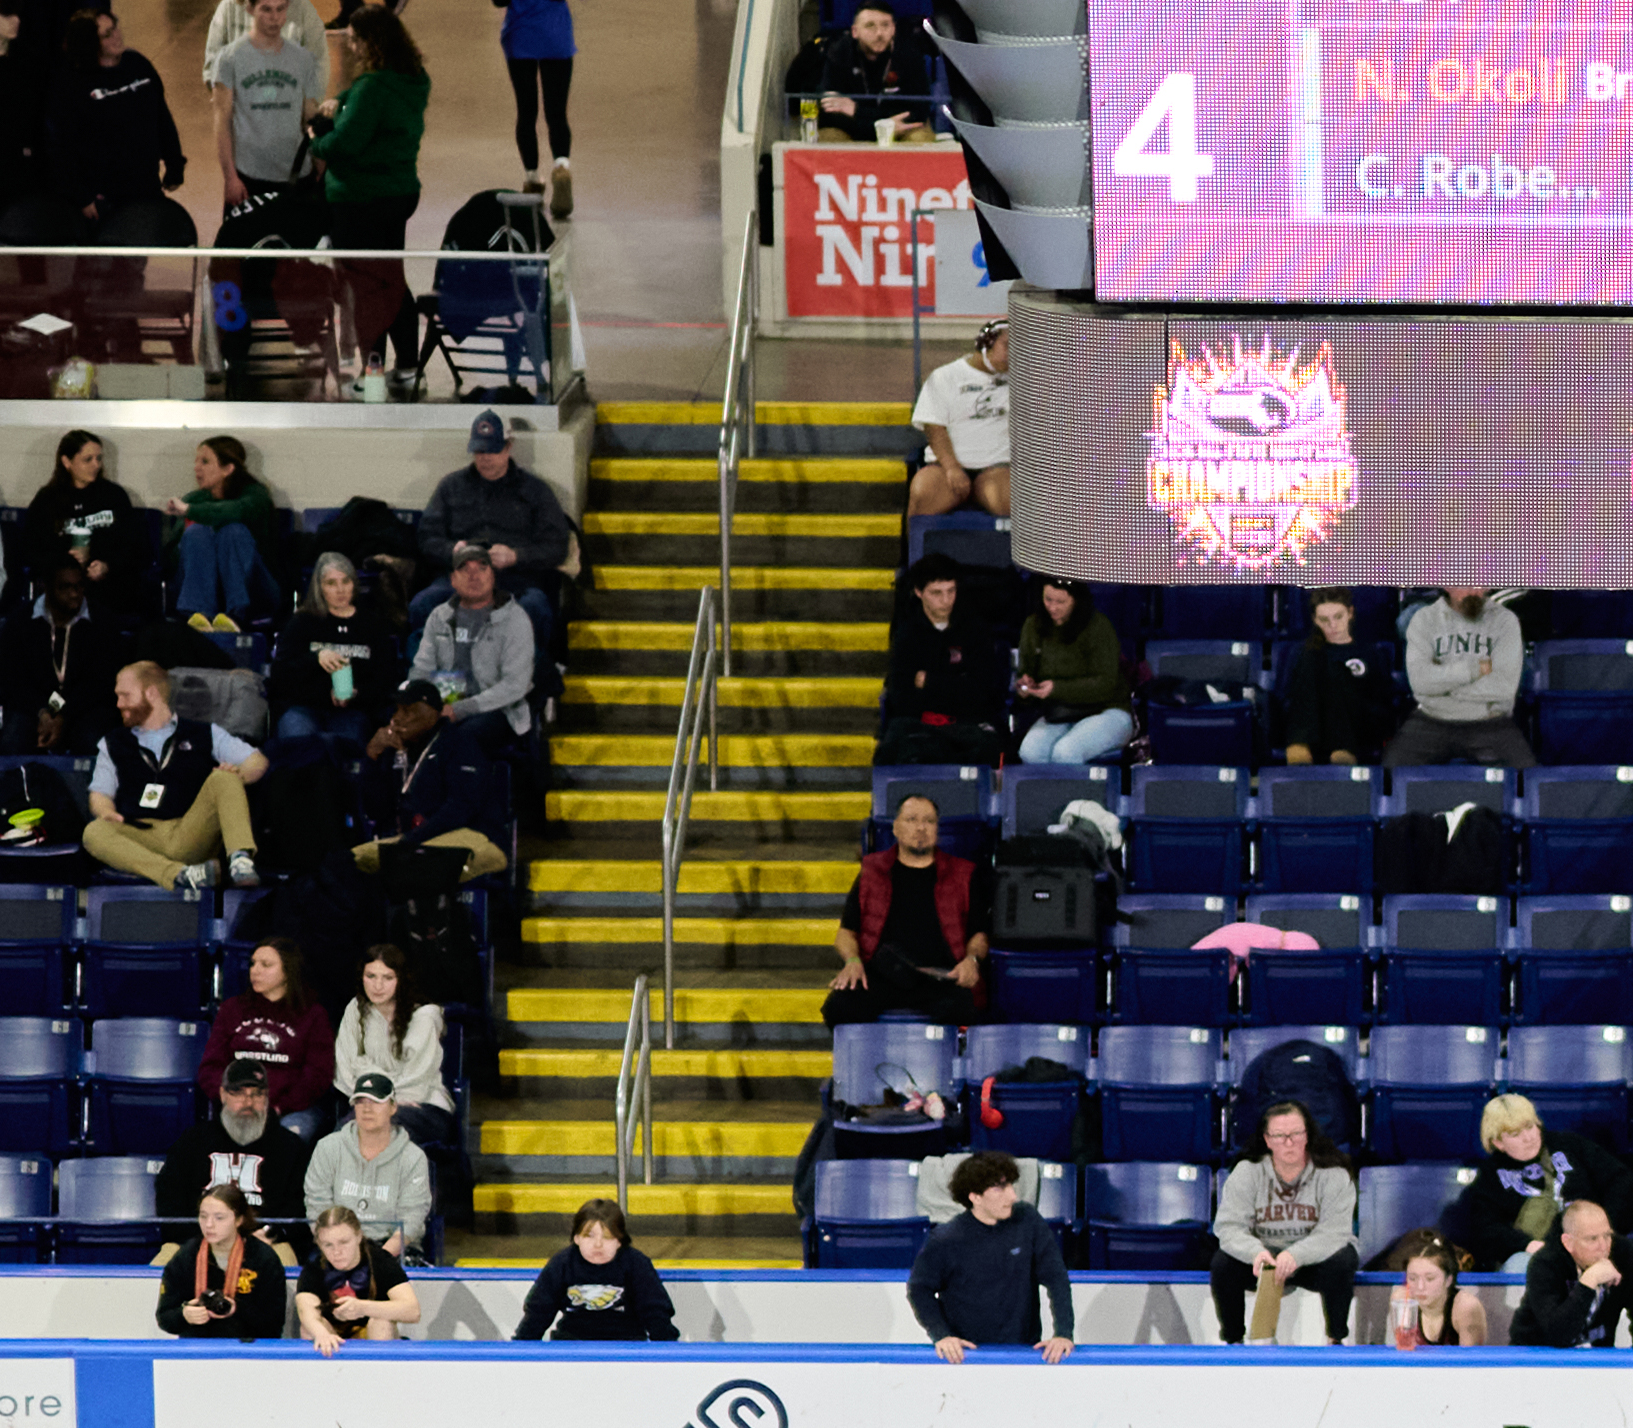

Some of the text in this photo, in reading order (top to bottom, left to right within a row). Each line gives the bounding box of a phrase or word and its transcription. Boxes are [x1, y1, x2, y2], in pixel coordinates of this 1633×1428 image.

[1354, 60, 1408, 102] N.
[1427, 59, 1567, 102] Okoli
[1114, 72, 1215, 204] 4
[1356, 154, 1404, 199] C.
[1436, 635, 1494, 658] UNH
